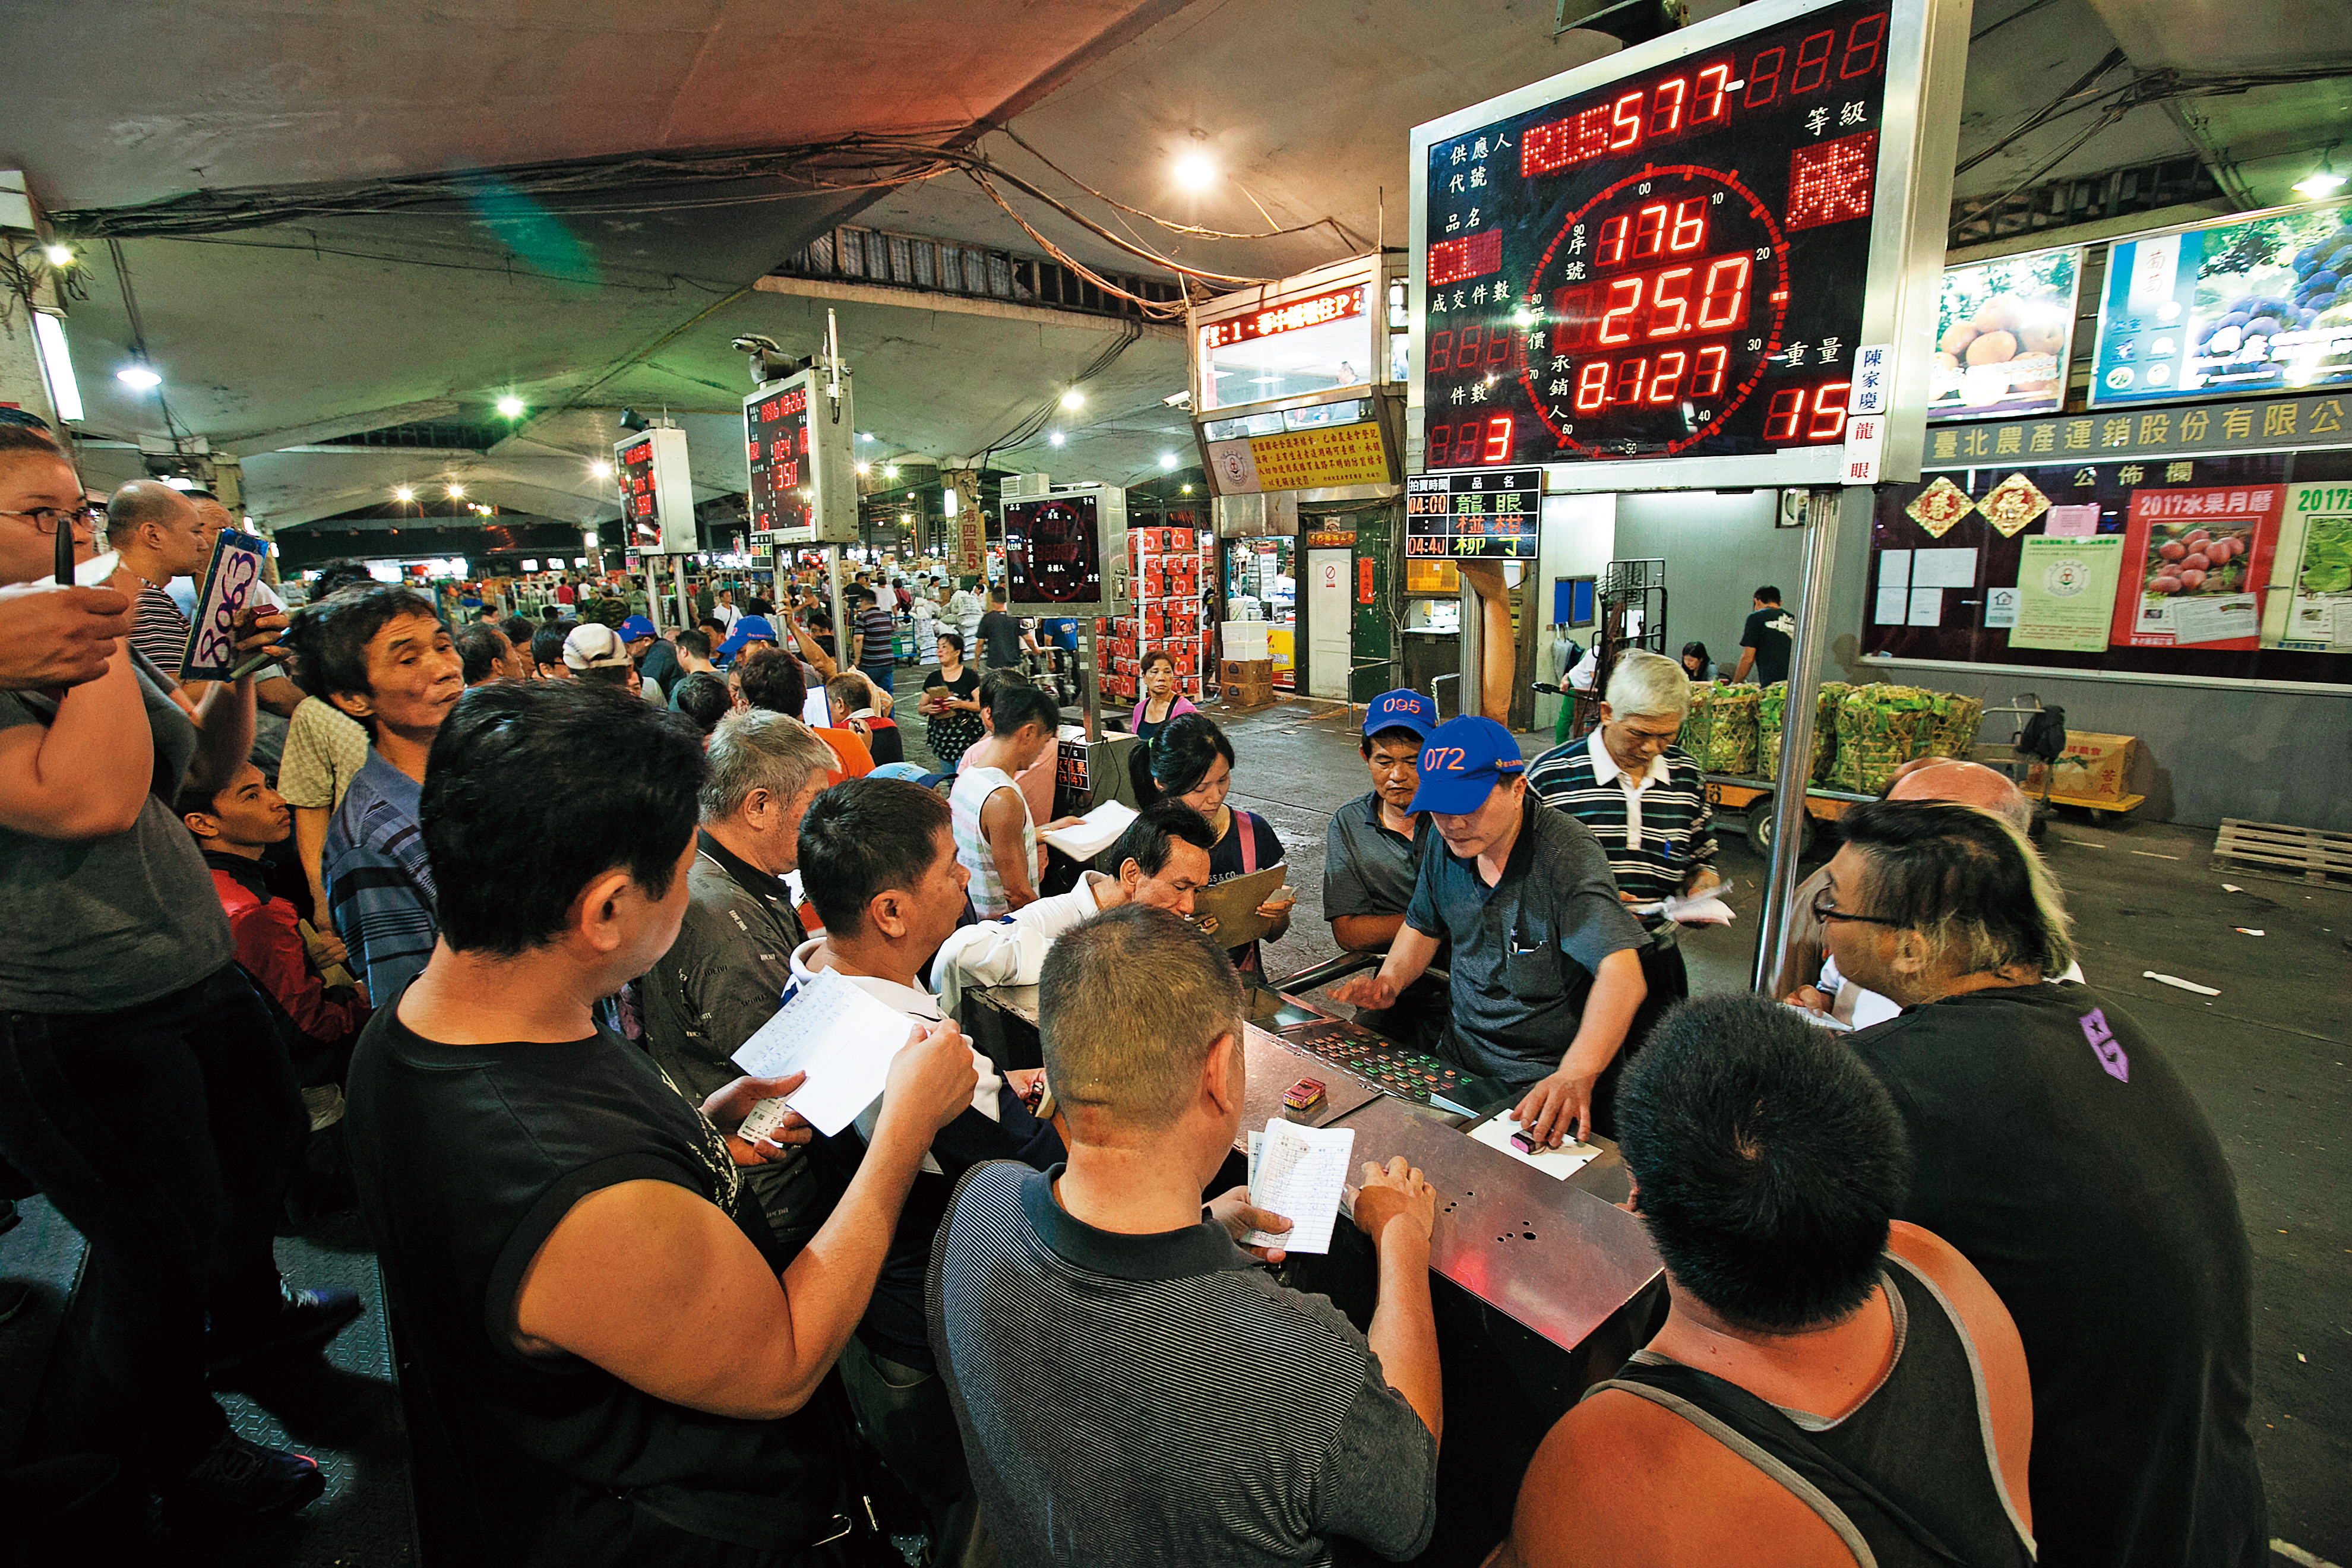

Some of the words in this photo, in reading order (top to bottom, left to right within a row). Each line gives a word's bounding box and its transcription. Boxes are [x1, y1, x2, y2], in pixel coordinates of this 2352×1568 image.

[1804, 100, 1867, 136] 等級
[1450, 132, 1513, 165] 供應人
[1449, 167, 1488, 194] 代號
[1638, 182, 1651, 195] 00
[1712, 192, 1724, 205] 10
[1445, 207, 1481, 233] 品名
[1573, 224, 1585, 236] 90
[1616, 203, 1703, 261] 176
[1566, 236, 1587, 280] 序號
[1756, 246, 1770, 260] 20
[1431, 280, 1510, 313] 成交件數
[1531, 293, 1542, 304] 80
[1599, 257, 1749, 344] 25.0
[1528, 306, 1546, 349] 單價
[1747, 339, 1762, 350] 30
[1784, 337, 1842, 368] 重量
[1529, 369, 1538, 379] 70
[1576, 346, 1727, 410] 8127
[1858, 349, 1883, 410] 陳家慶
[1450, 383, 1487, 405] 件數
[1548, 355, 1571, 419] 承銷人
[1698, 410, 1711, 421] 40
[1788, 383, 1851, 437] 15
[1484, 418, 1512, 461] 3
[1562, 424, 1573, 435] 60
[1933, 399, 2345, 459] 臺北農產運銷股份有限公
[1625, 442, 1637, 455] 50
[1851, 422, 1874, 478] 龍眼
[1409, 478, 1448, 492] 拍賣時間
[1472, 476, 1514, 489] 品名
[2073, 461, 2193, 486] 公佈欄
[1409, 495, 1446, 514] 04:00
[1456, 493, 1523, 514] 龍眼
[1456, 514, 1523, 534] 椪柑
[1453, 536, 1521, 557] 柳丁
[1383, 698, 1421, 714] 095
[1424, 747, 1465, 772] 072
